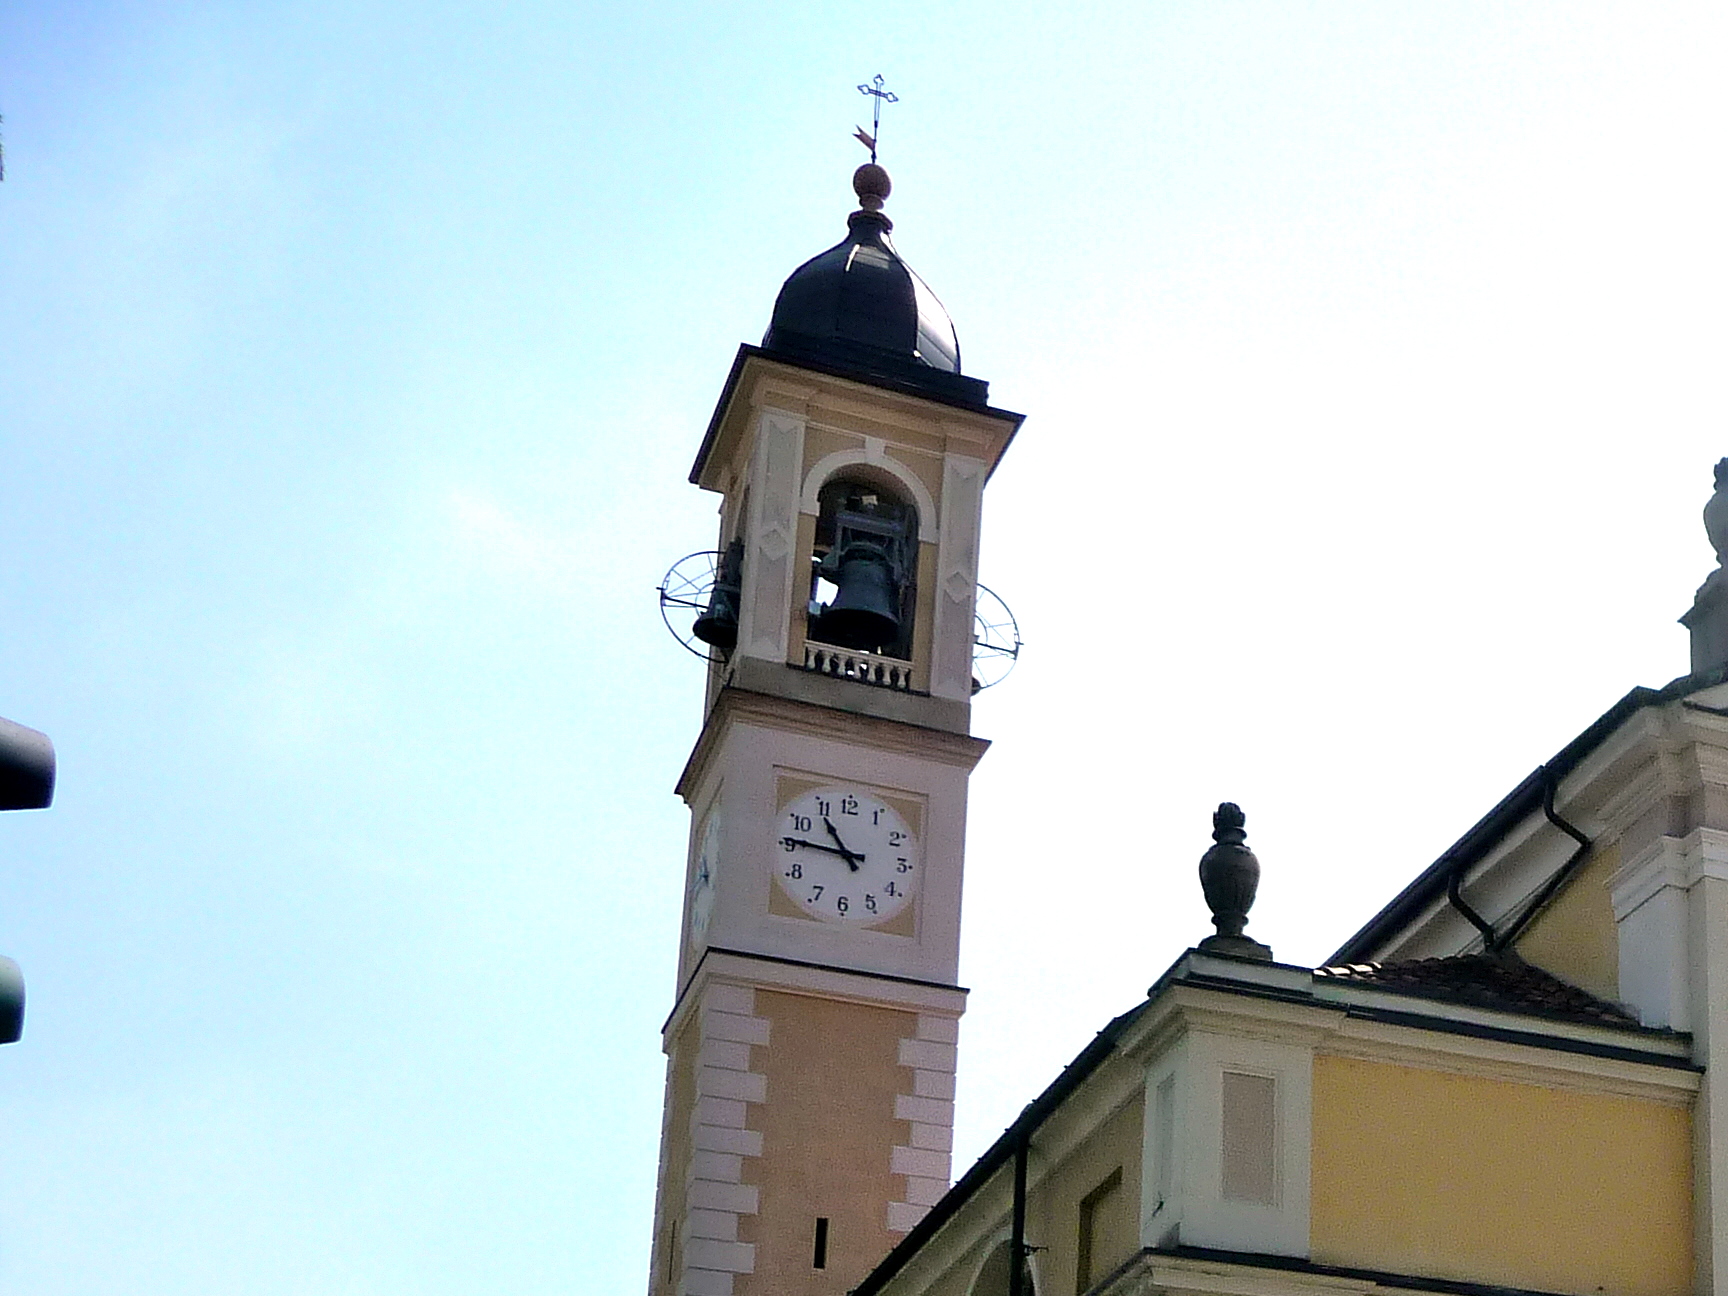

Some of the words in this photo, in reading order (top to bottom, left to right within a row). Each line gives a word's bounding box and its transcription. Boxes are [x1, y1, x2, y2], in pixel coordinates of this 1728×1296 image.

[818, 801, 830, 816] 11
[842, 799, 858, 815] 12
[794, 815, 812, 832] 10
[873, 810, 878, 825] 1
[889, 831, 900, 847] 2
[791, 864, 803, 879] 8
[896, 857, 907, 873] 3
[813, 885, 824, 901] 7
[884, 881, 896, 897] 4
[837, 896, 848, 912] 6
[865, 894, 876, 910] 5
